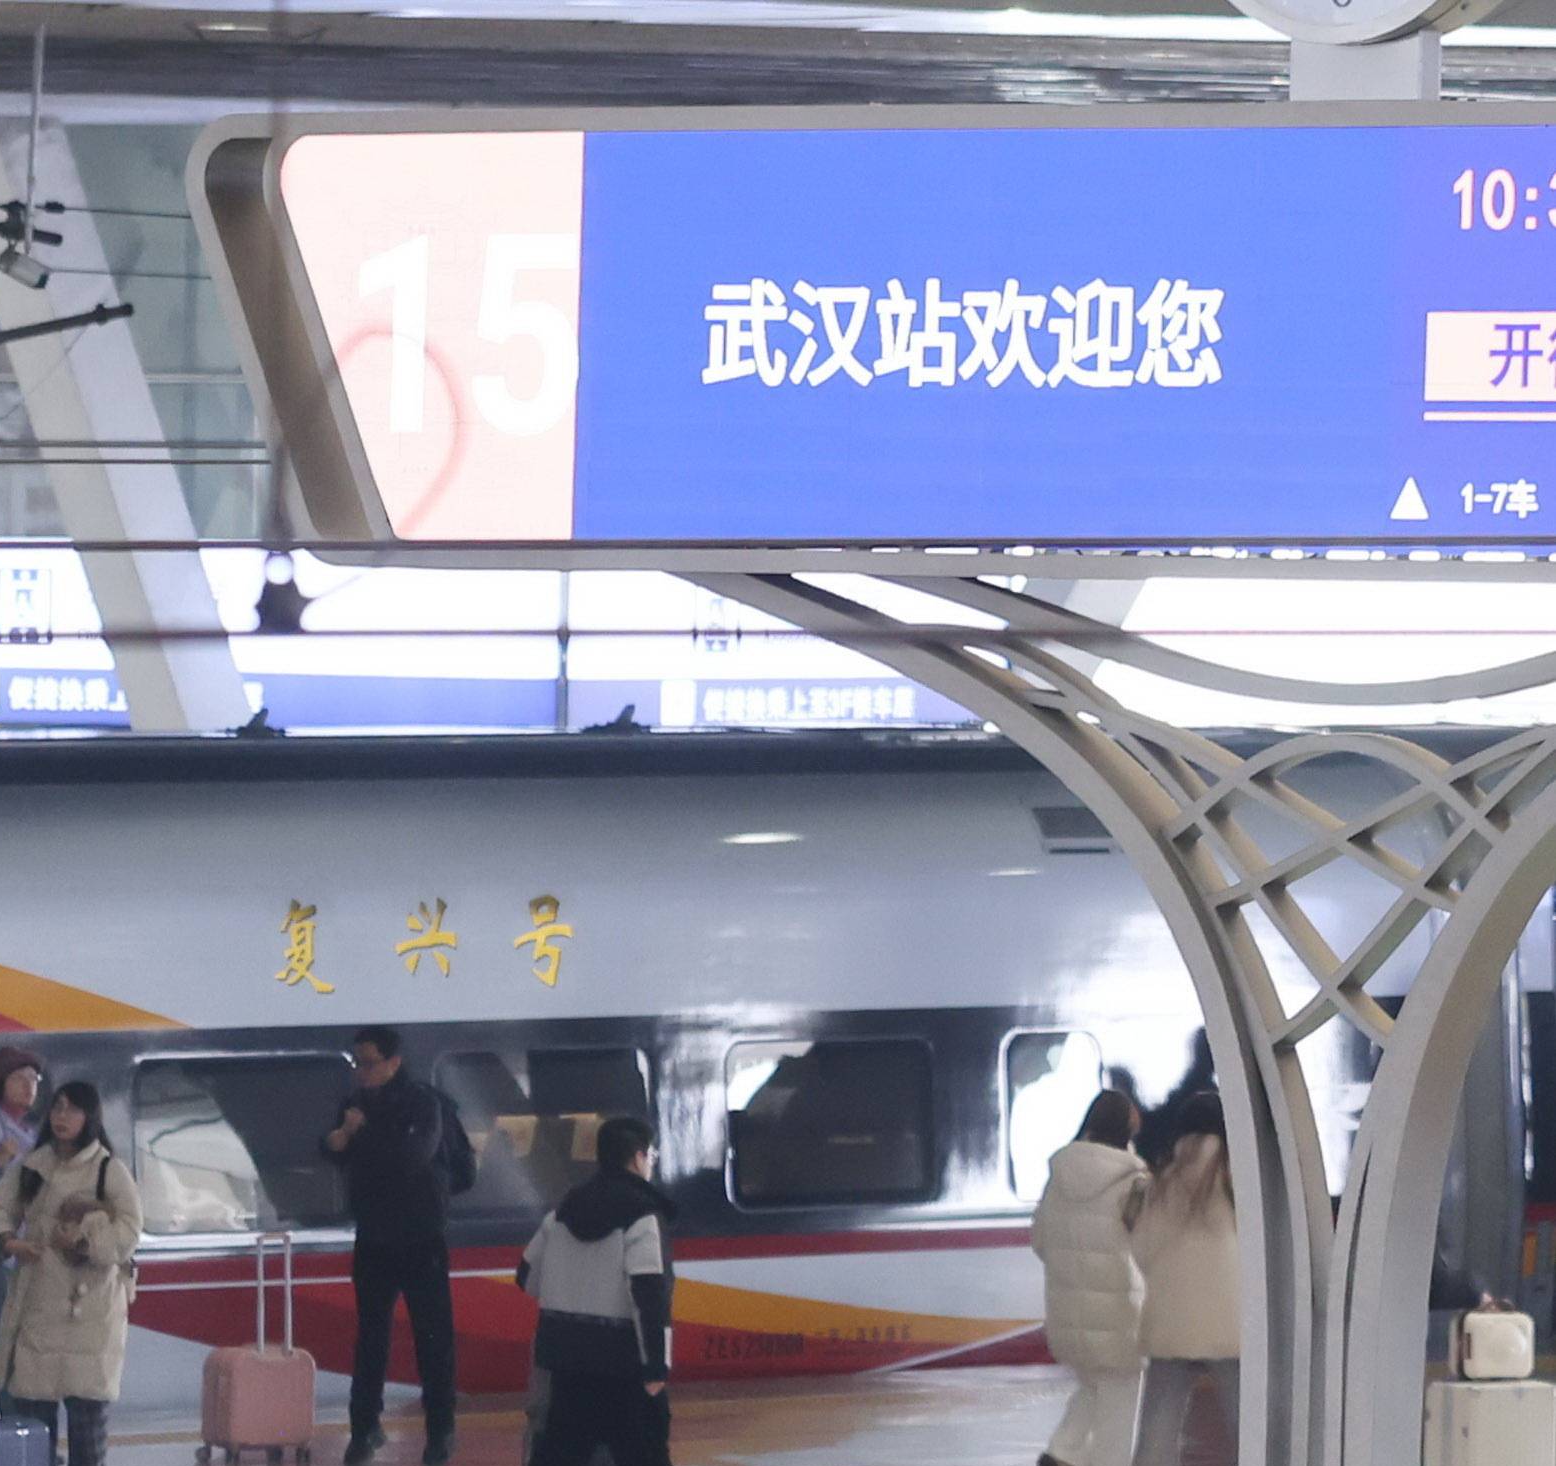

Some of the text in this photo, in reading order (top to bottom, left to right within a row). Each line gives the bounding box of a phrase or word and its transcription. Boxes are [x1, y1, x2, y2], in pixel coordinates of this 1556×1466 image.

[1452, 168, 1556, 232] 10:
[357, 231, 579, 437] 15
[701, 276, 1225, 389] 武汉站欢迎您
[1488, 322, 1556, 389] 开
[1460, 478, 1539, 519] 1-7车
[274, 894, 575, 994] 复兴号
